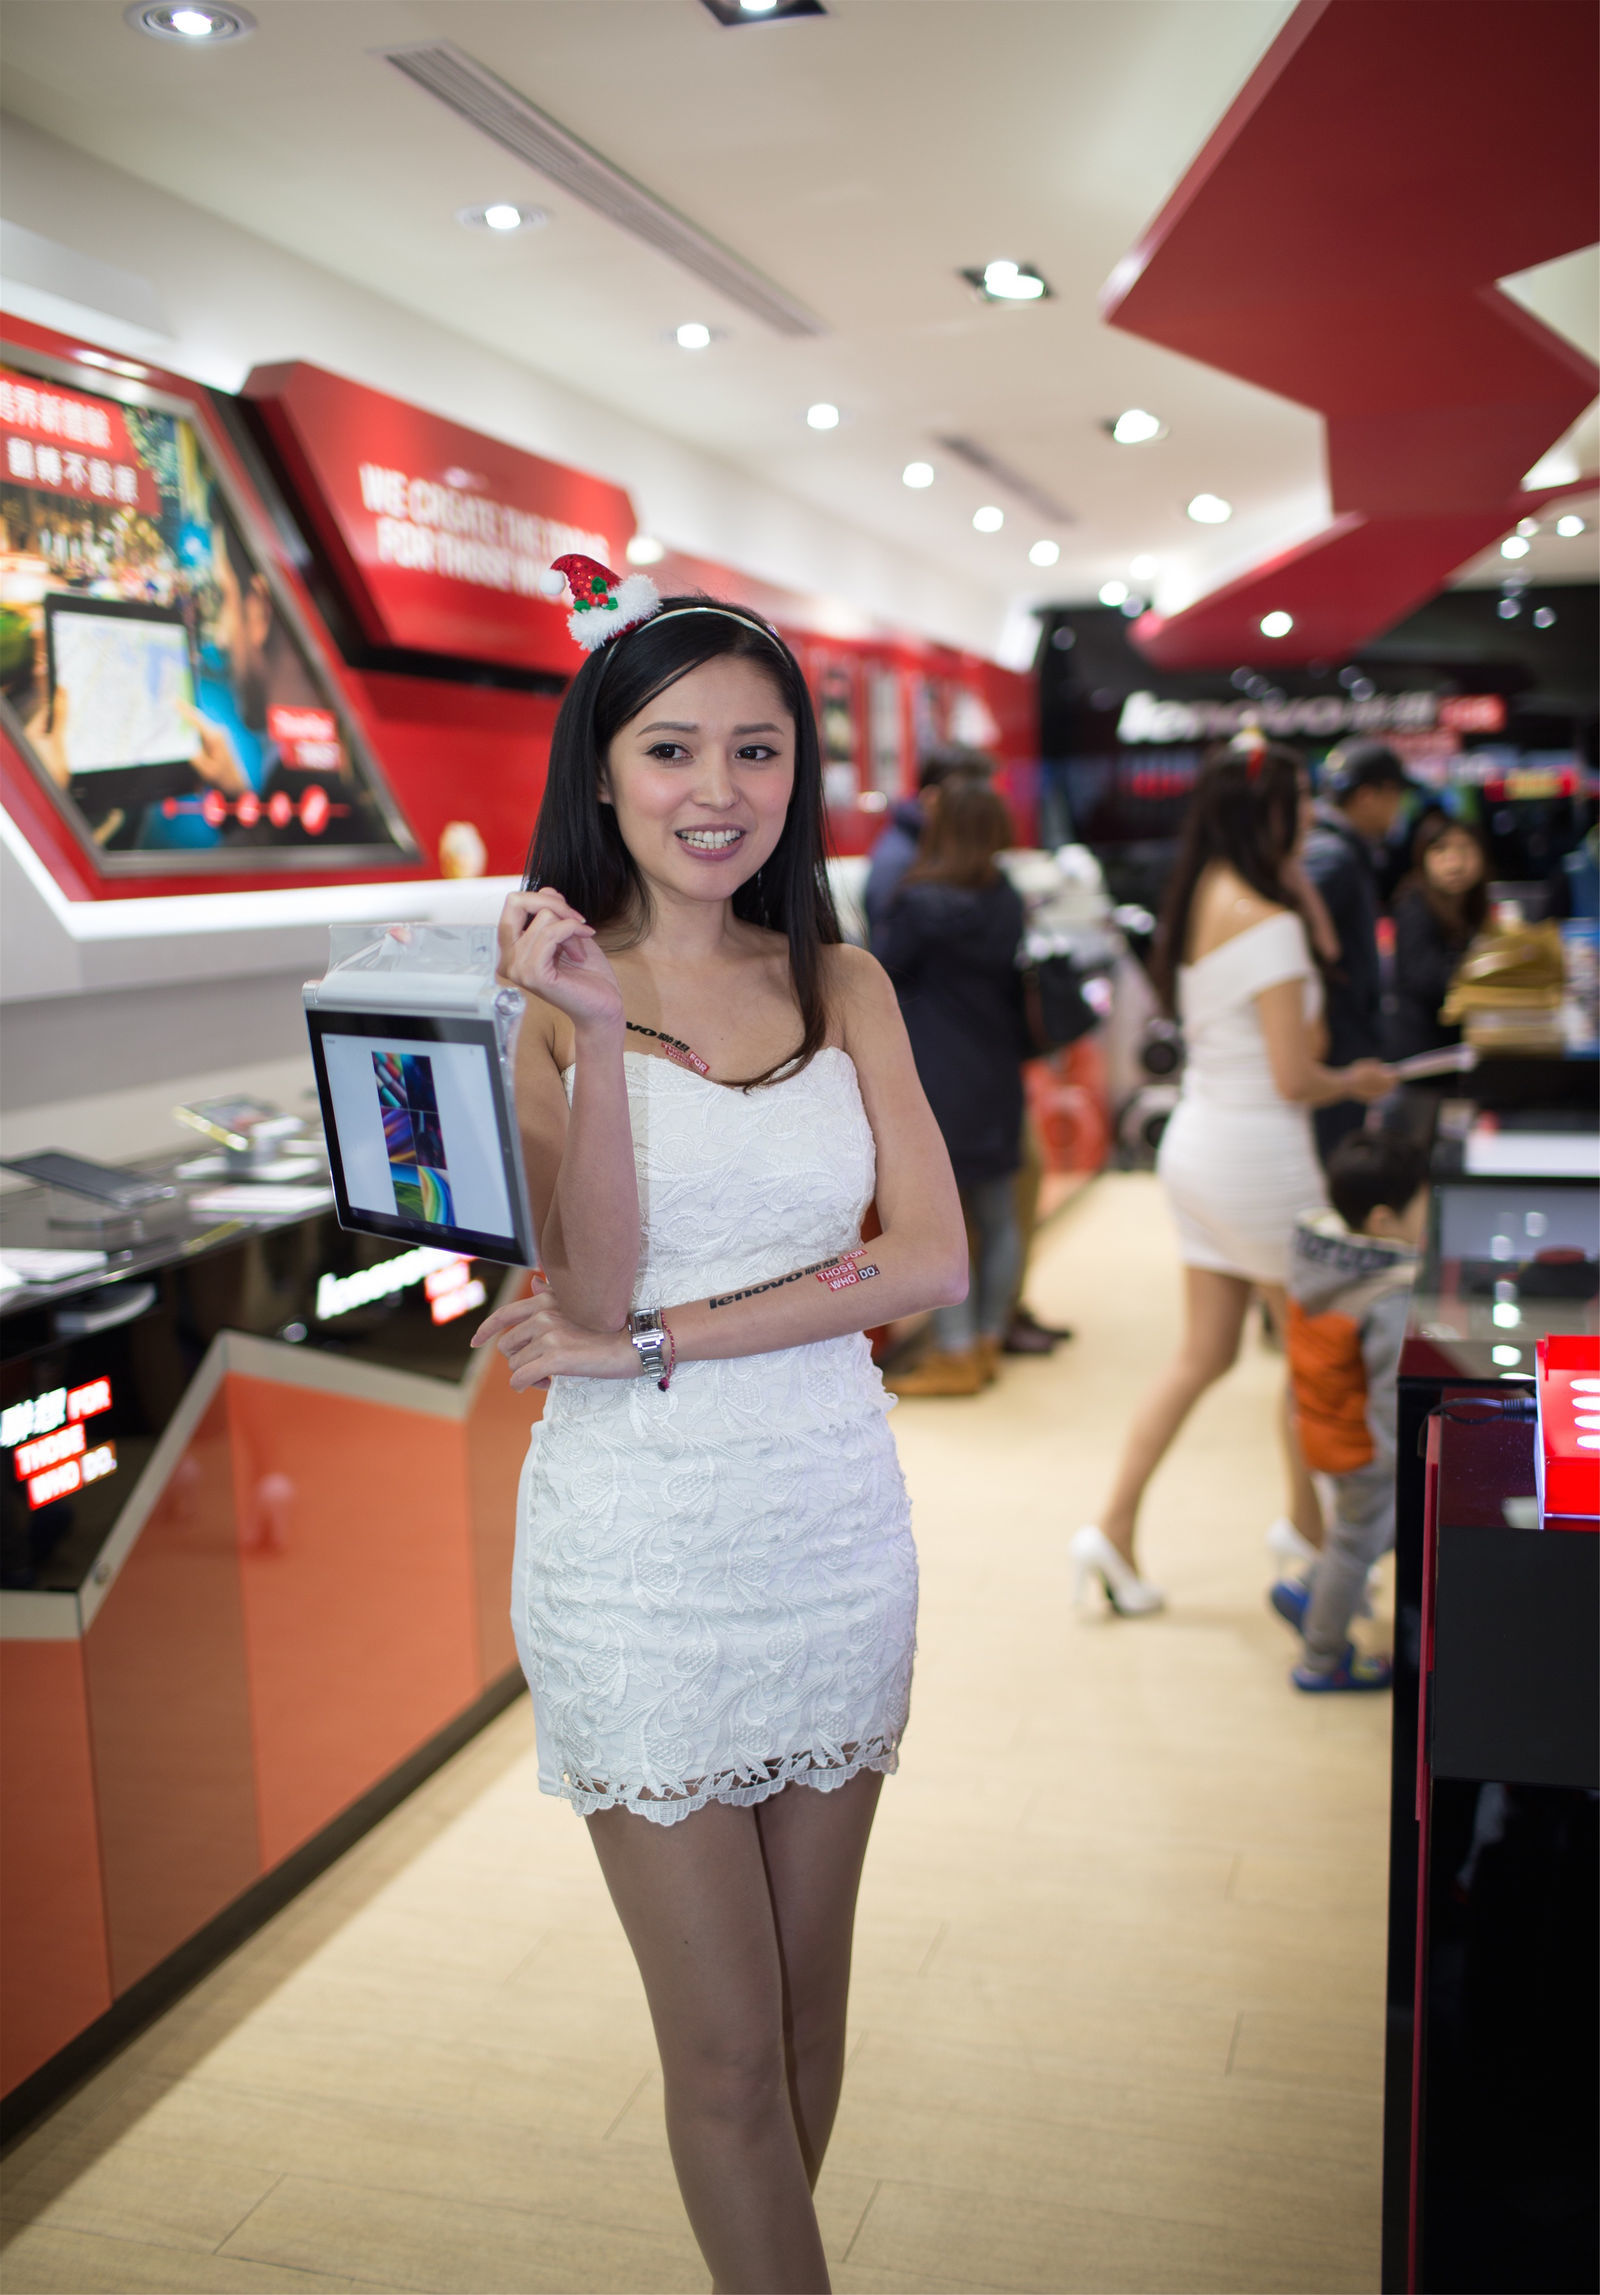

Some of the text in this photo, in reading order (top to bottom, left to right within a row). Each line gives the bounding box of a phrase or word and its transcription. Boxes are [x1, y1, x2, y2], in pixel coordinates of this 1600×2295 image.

[359, 462, 409, 519] WE
[376, 516, 437, 572] FOR
[689, 1052, 708, 1073] FOR
[709, 1271, 803, 1310] lenovo
[817, 1261, 856, 1282] THOSE
[828, 1266, 881, 1291] WHO DO.
[68, 1379, 112, 1420] FOR
[31, 1460, 80, 1506] WHO
